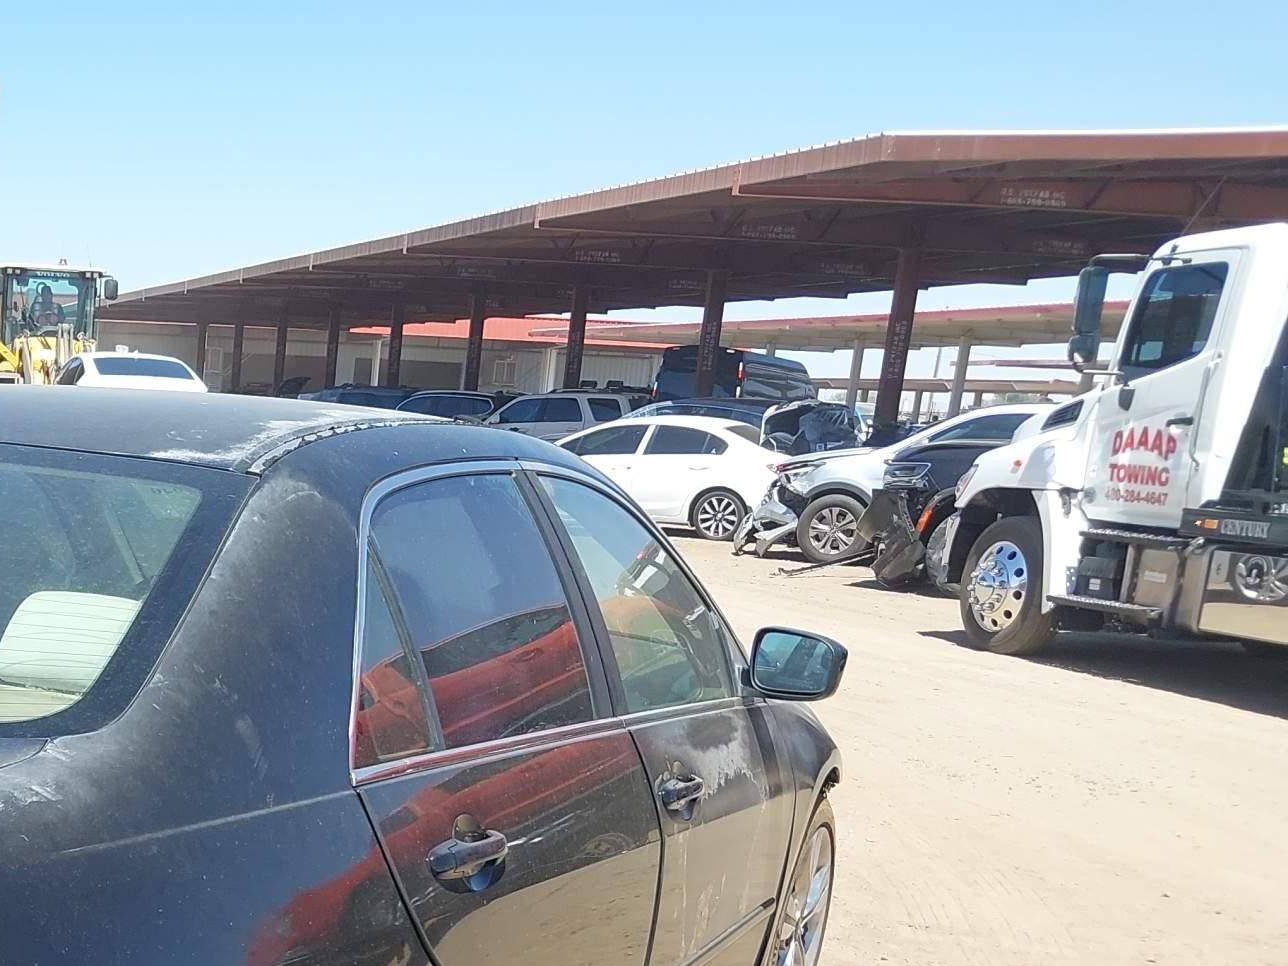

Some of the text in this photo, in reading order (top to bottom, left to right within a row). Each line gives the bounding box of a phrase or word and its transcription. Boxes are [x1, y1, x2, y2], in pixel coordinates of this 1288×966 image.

[1112, 426, 1177, 461] DAAAP
[1109, 463, 1170, 487] TOWING
[1220, 519, 1272, 539] CENTURY
